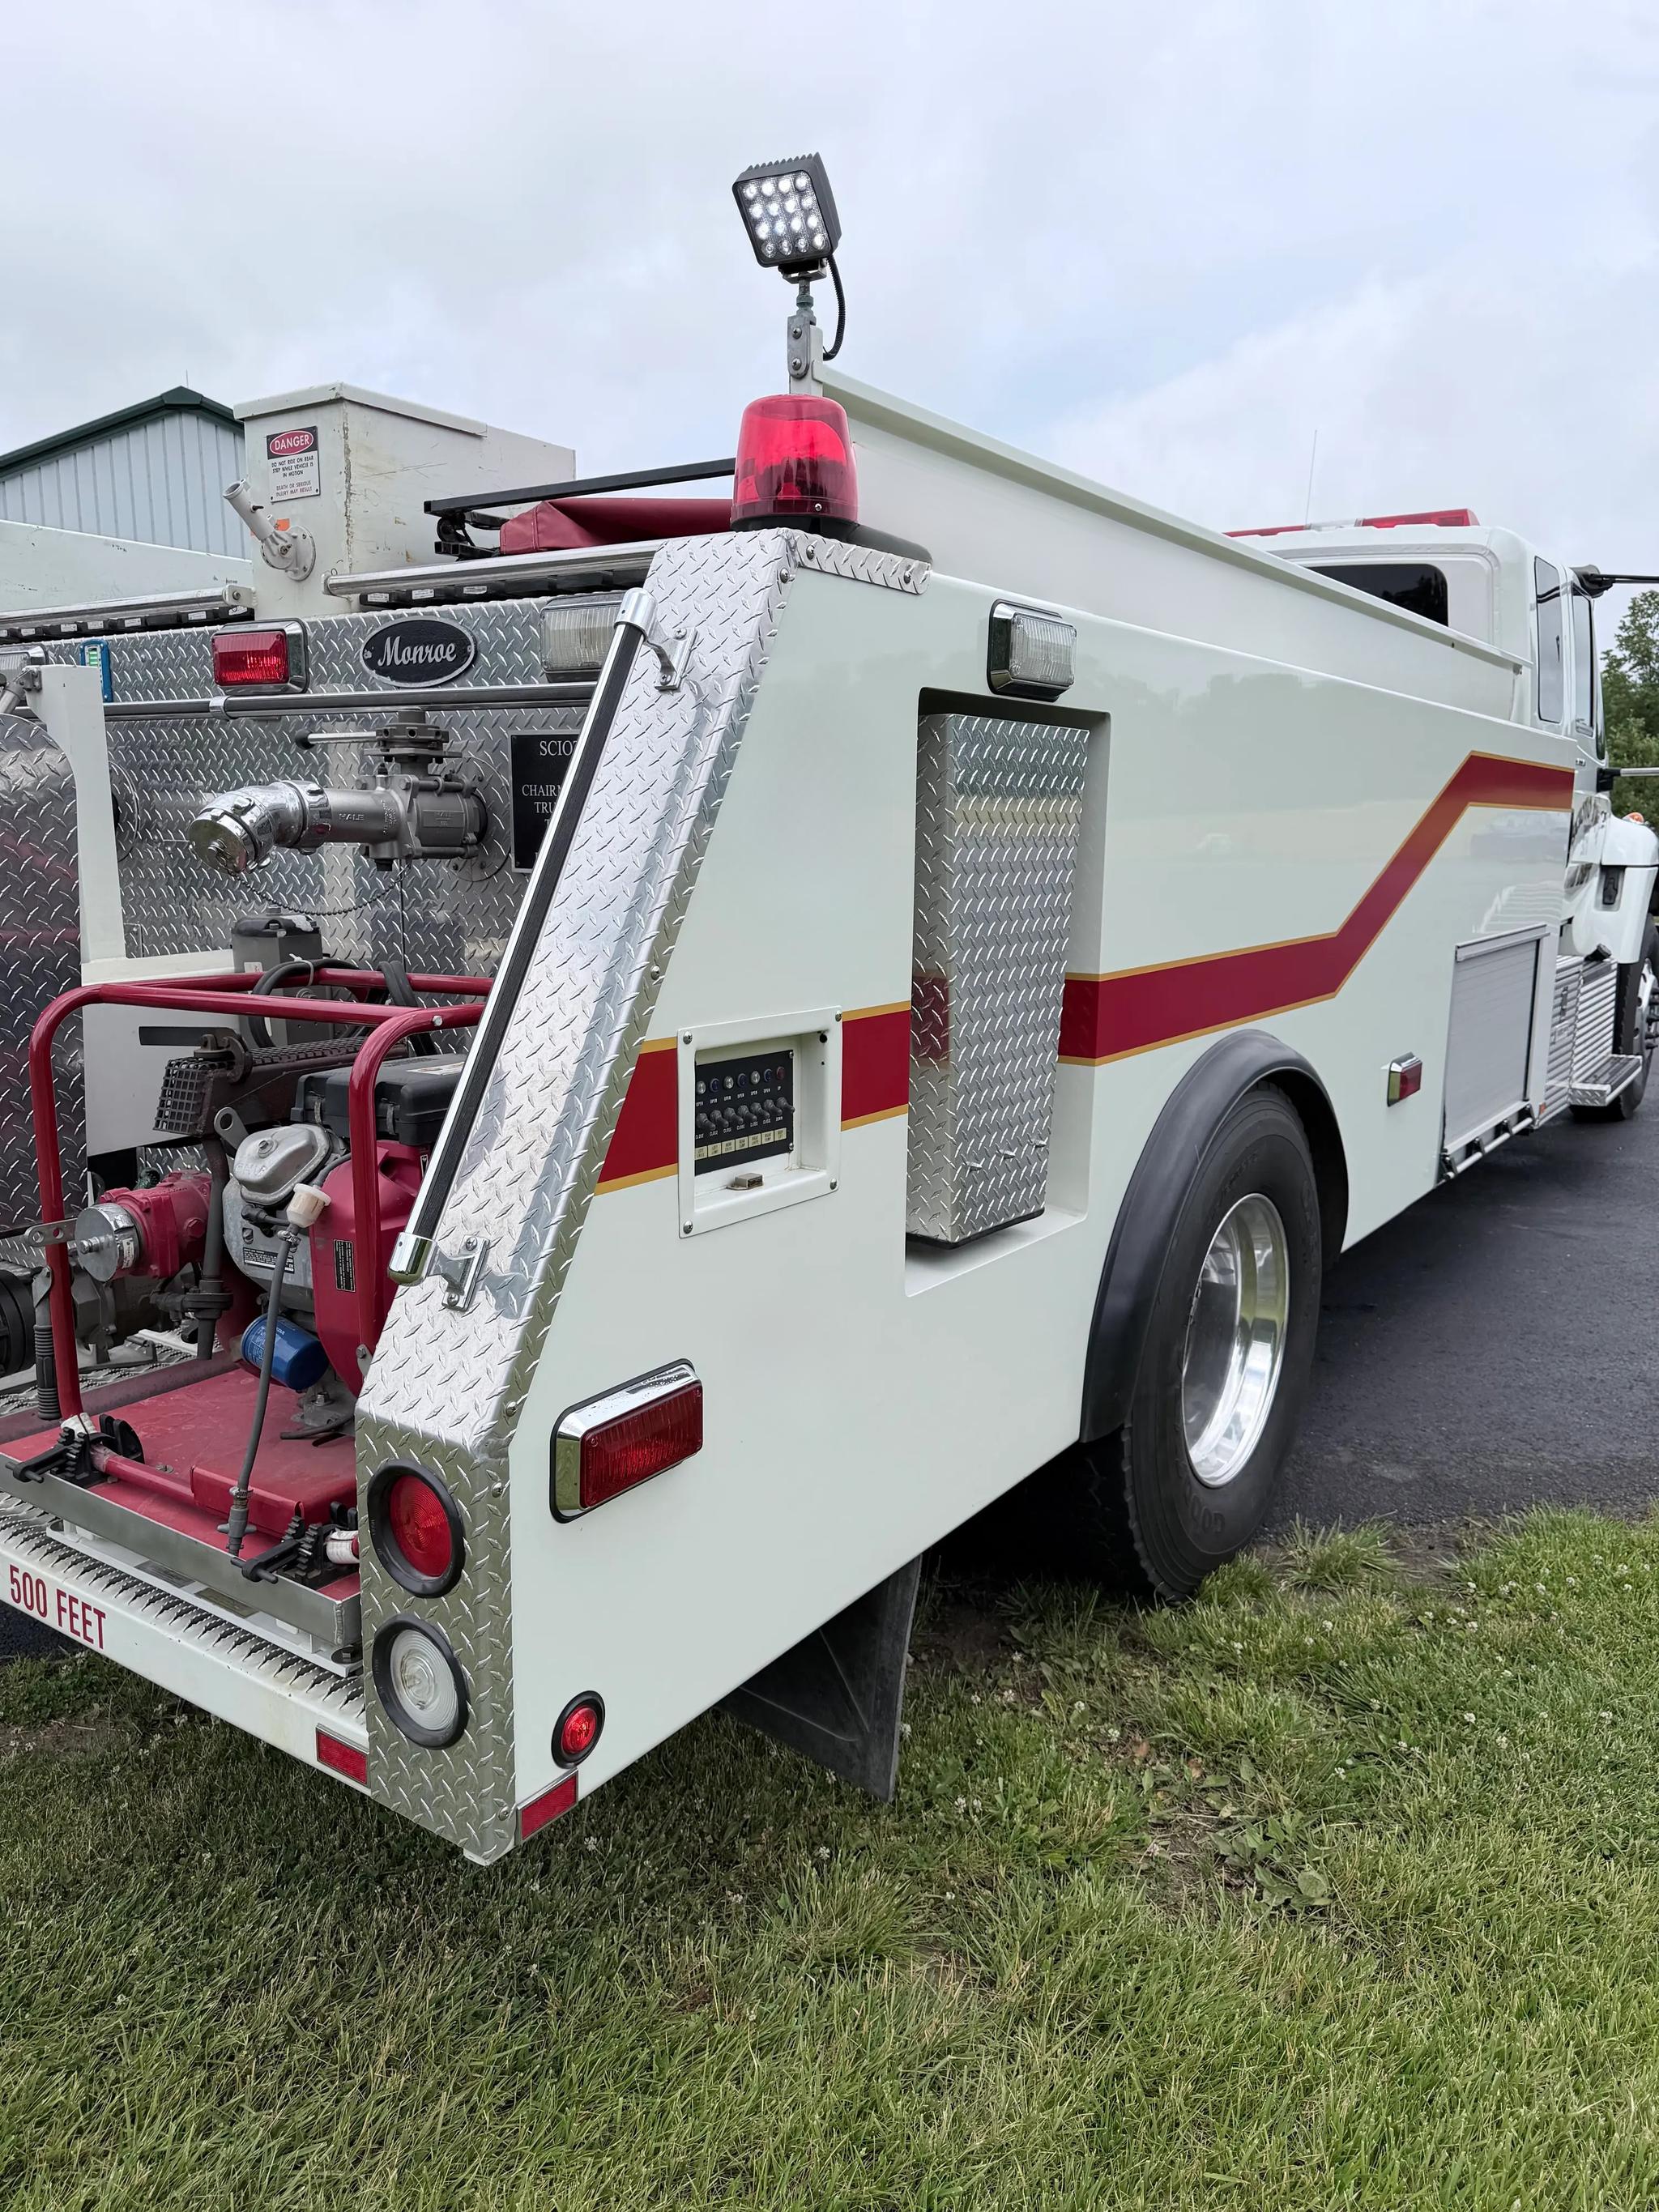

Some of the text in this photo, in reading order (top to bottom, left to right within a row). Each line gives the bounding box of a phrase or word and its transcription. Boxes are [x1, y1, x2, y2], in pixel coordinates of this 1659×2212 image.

[275, 434, 309, 450] DANGER
[377, 636, 457, 667] Monroe
[339, 813, 365, 821] HALE
[10, 1564, 106, 1650] 500 FEET
